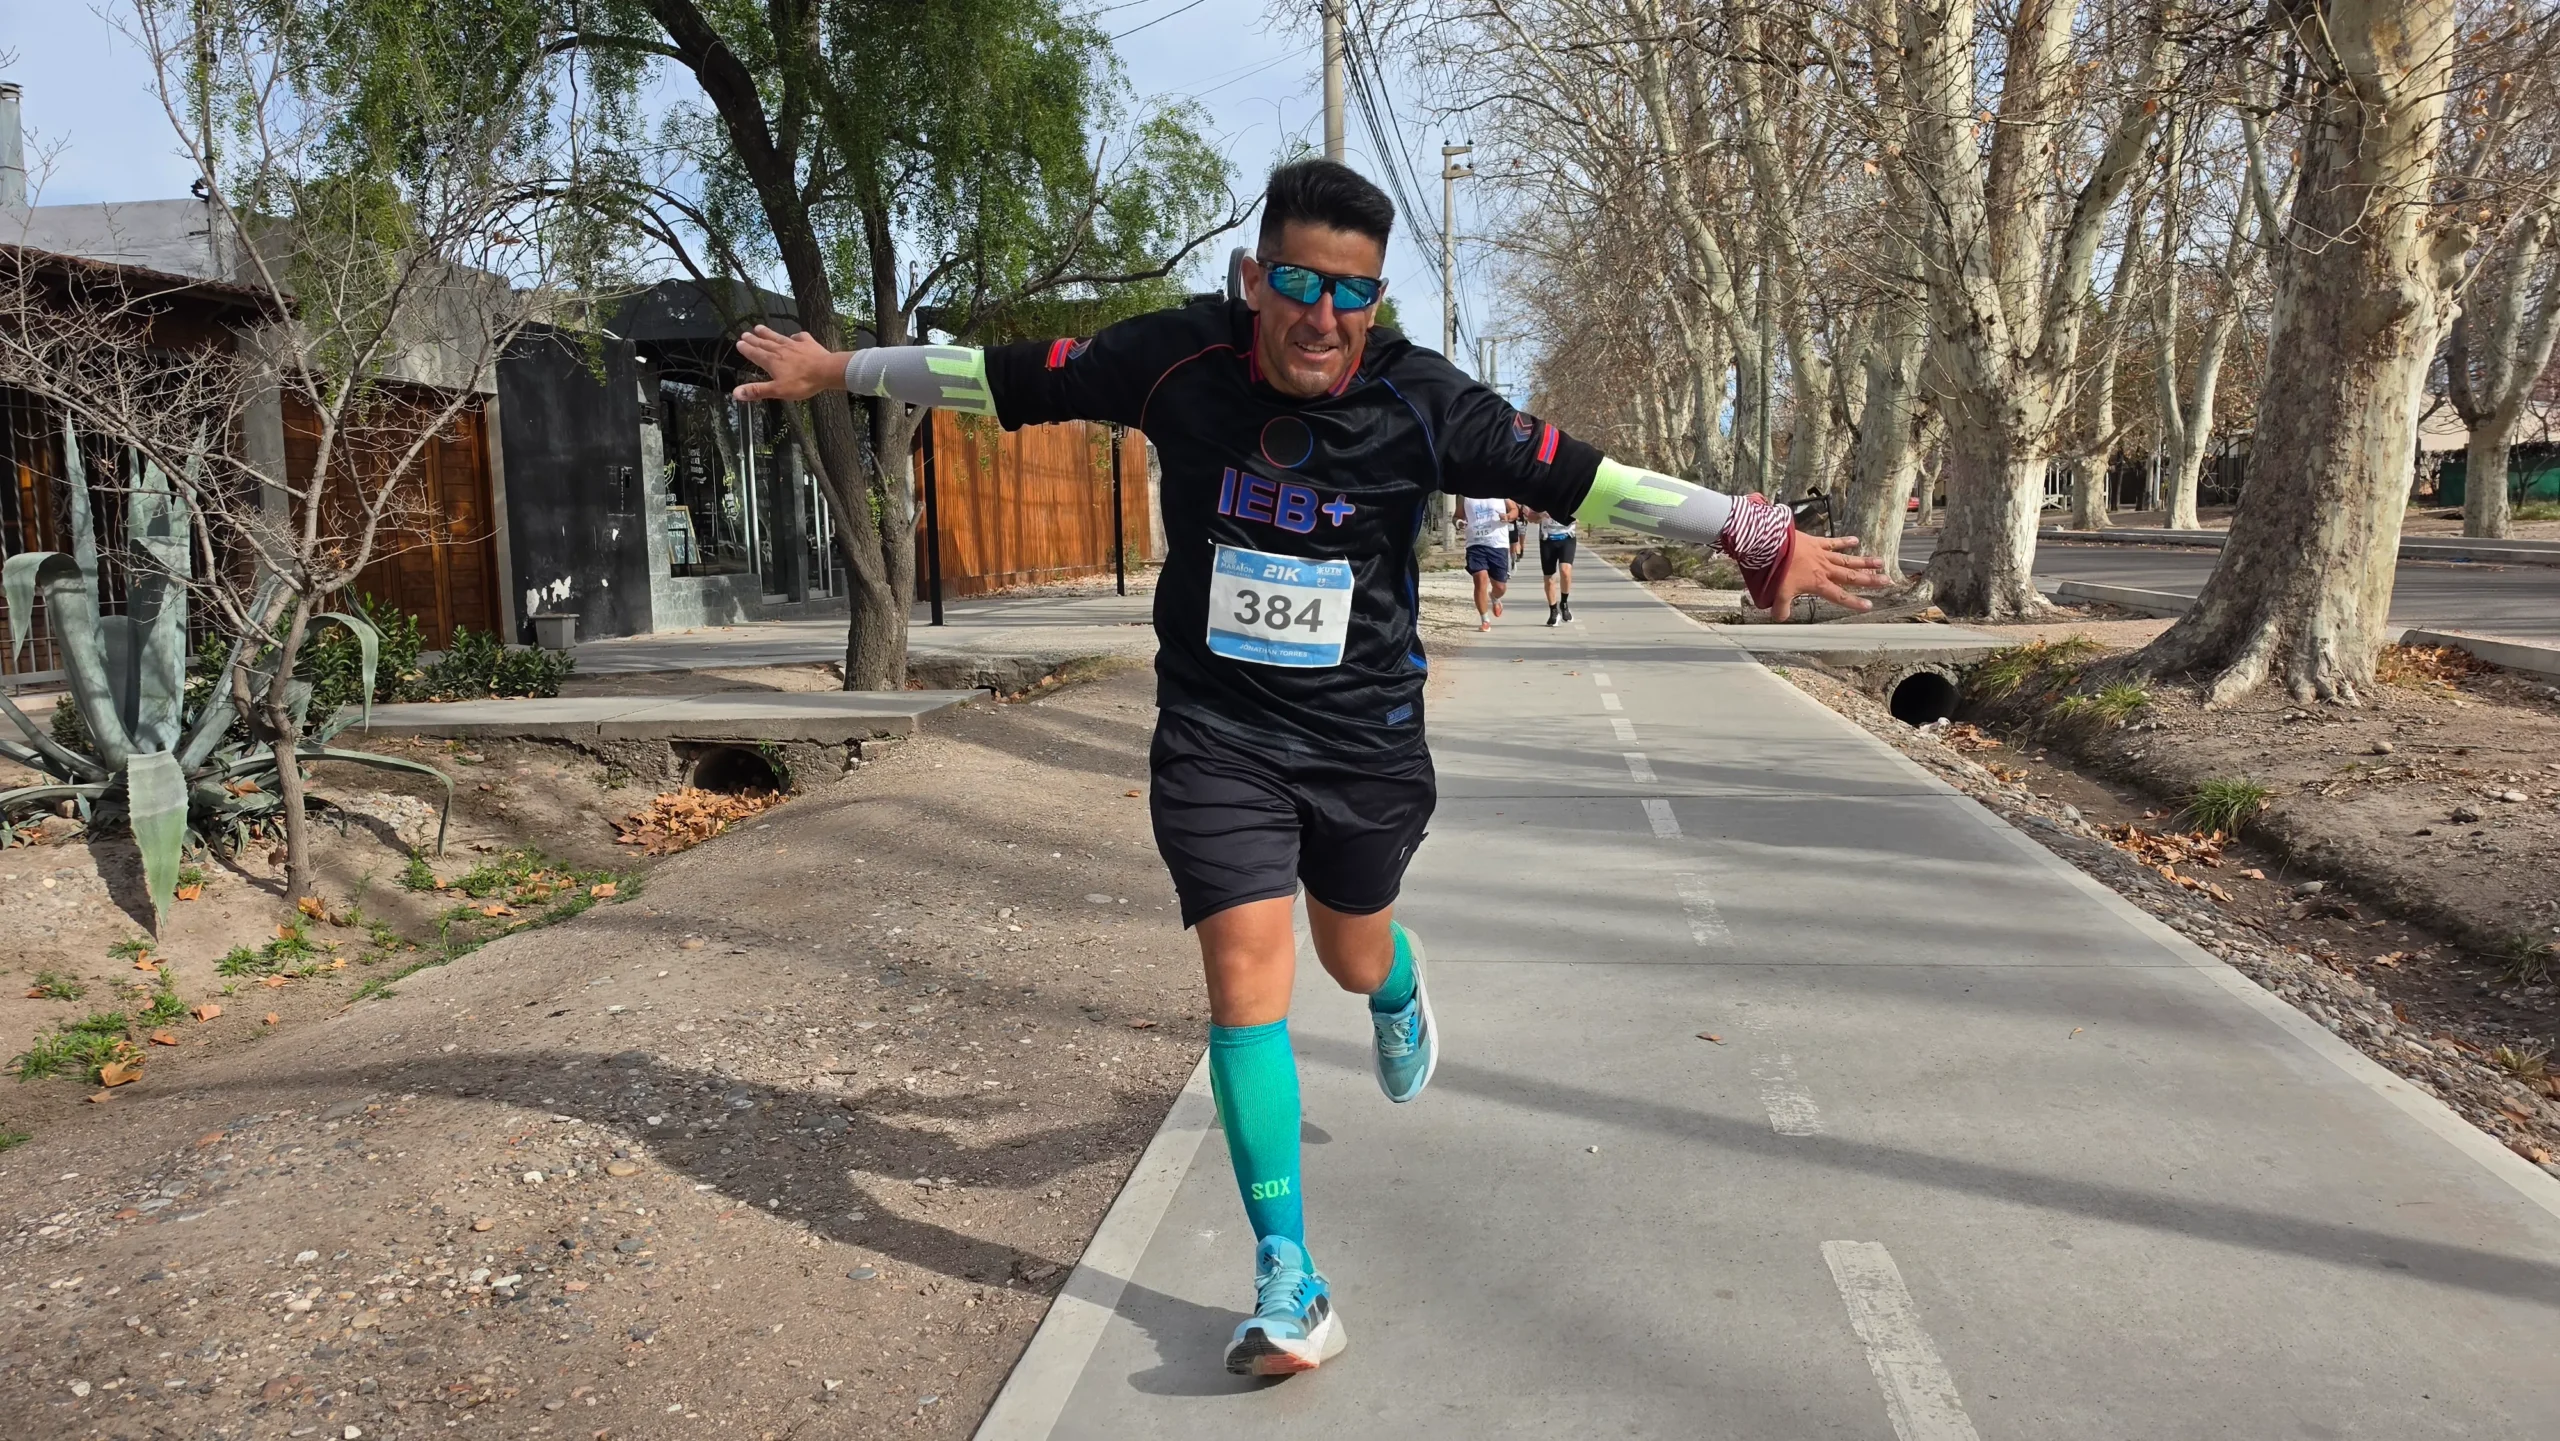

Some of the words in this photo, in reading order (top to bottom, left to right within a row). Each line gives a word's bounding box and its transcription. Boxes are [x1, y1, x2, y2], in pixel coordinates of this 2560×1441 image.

[1217, 466, 1356, 534] IEB+
[1263, 563, 1302, 583] 21K
[1324, 565, 1342, 574] UTN
[1233, 589, 1324, 633] 384
[1239, 643, 1277, 656] JONATHAN
[1279, 650, 1308, 658] TORRES
[1251, 1176, 1291, 1201] SOX
